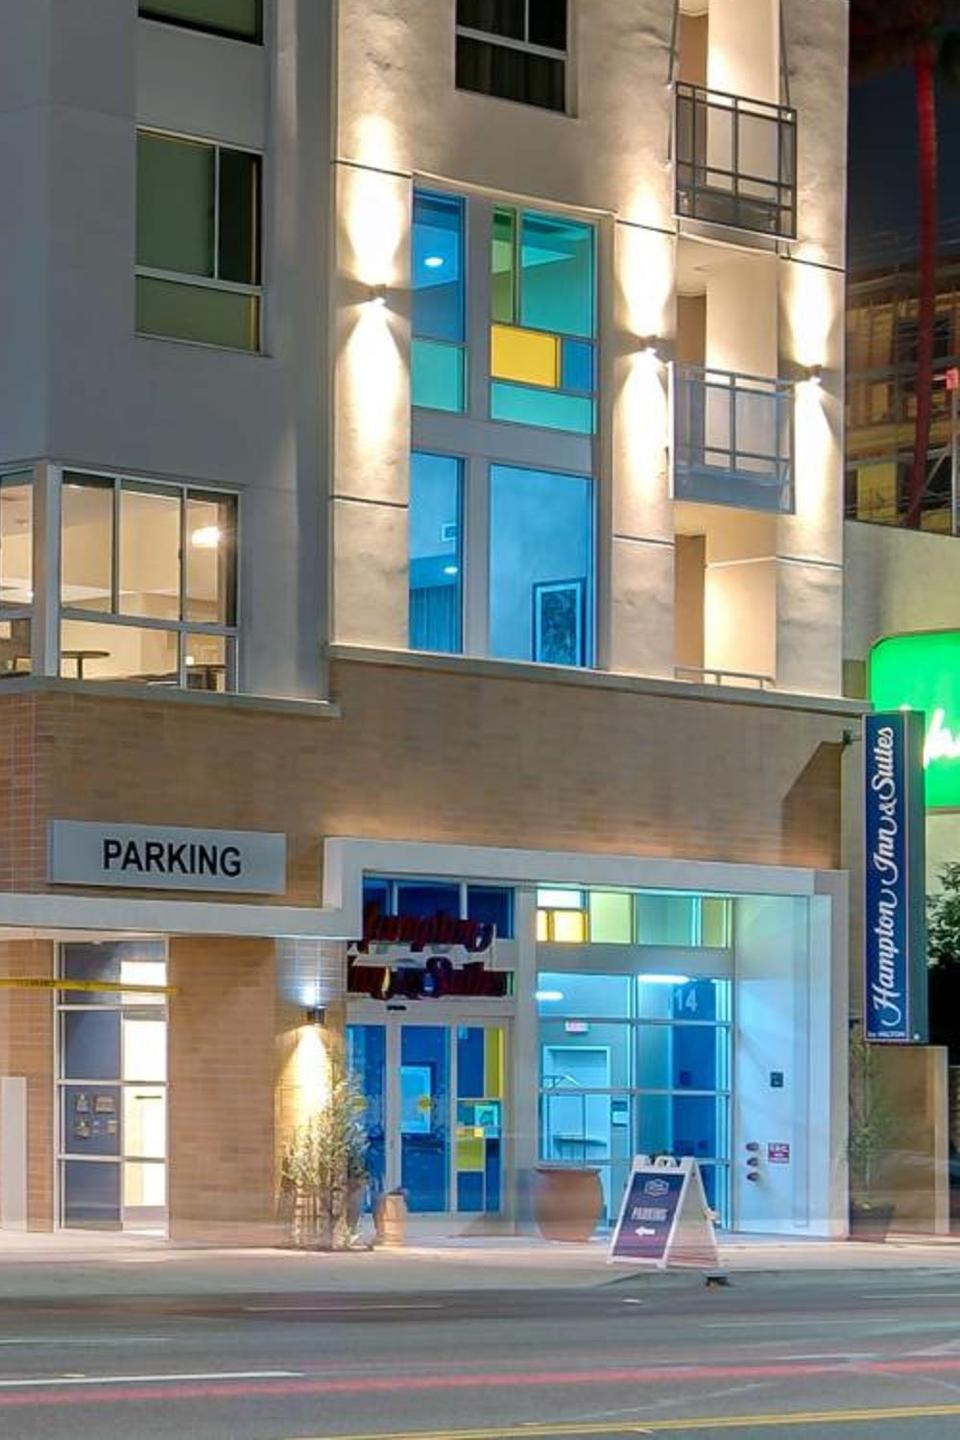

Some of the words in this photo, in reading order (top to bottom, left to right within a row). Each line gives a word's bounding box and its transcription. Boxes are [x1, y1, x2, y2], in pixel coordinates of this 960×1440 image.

[871, 725, 896, 801] Suites
[878, 797, 898, 816] &
[103, 838, 242, 878] PARKING
[872, 815, 899, 886] Inn
[872, 887, 902, 1027] Hampton
[675, 988, 699, 1012] 14
